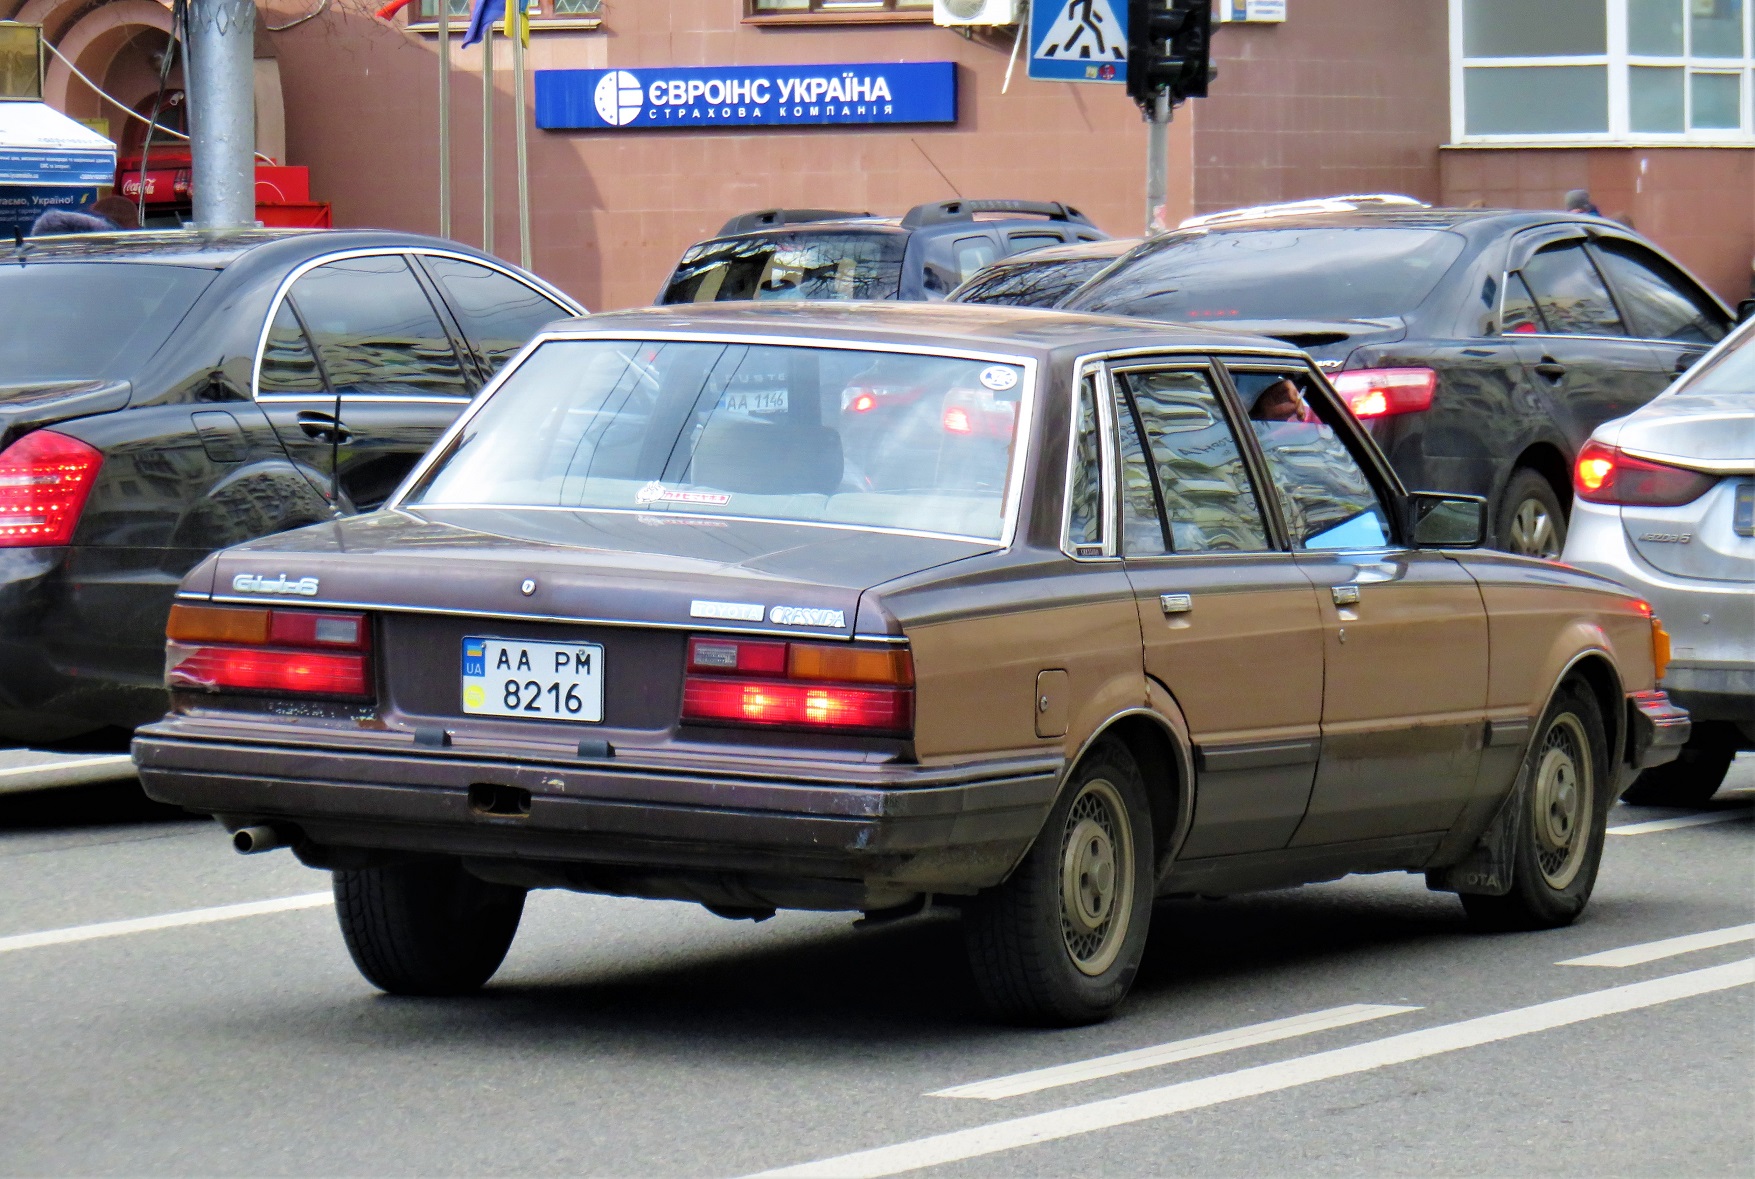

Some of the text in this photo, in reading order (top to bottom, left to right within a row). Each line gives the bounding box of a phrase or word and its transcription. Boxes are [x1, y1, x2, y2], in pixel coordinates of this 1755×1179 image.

[649, 72, 892, 106] ЄВРОІНС УКРАЇНА
[649, 105, 893, 119] СТРАХОВА КОМПАНІЯ
[32, 195, 74, 206] Україно!
[727, 391, 784, 411] AA 1146
[698, 603, 761, 620] TOYOTA
[466, 663, 482, 674] UA
[496, 648, 591, 675] AA PM
[503, 679, 583, 714] 8216
